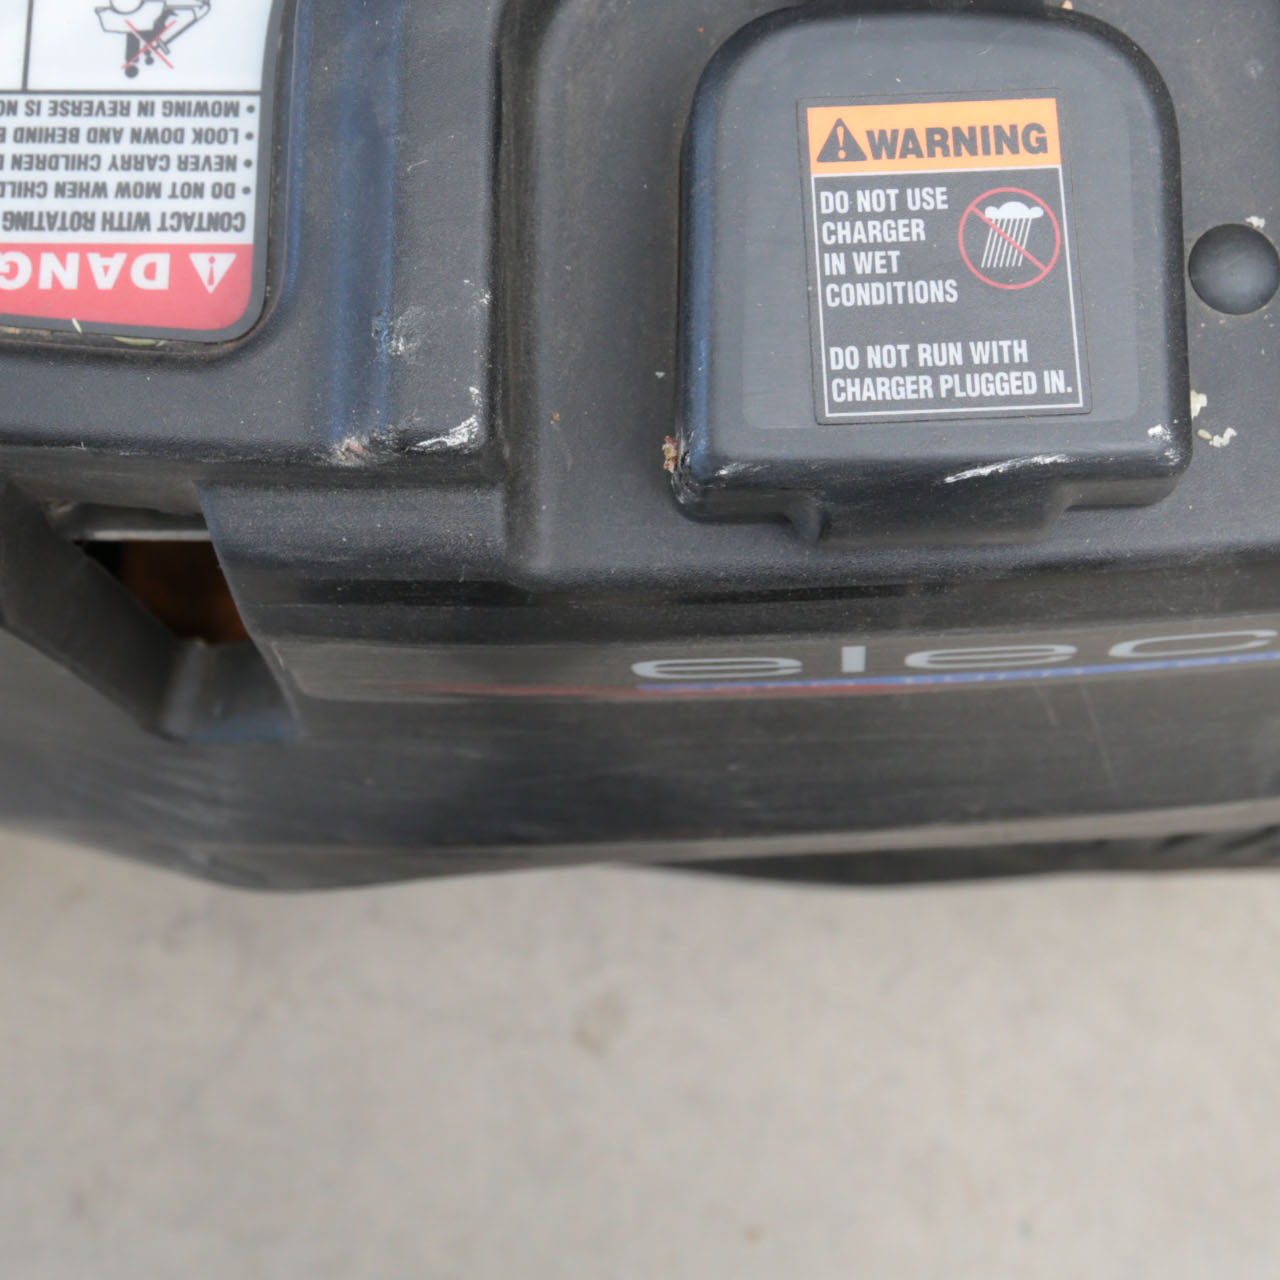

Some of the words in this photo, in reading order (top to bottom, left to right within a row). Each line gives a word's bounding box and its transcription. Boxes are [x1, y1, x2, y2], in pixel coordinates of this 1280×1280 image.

[23, 99, 43, 118] IS
[47, 99, 132, 118] REVERSE
[136, 99, 156, 118] IN
[161, 100, 241, 119] MOWING
[11, 126, 81, 145] BEHIND
[85, 126, 125, 145] AND
[129, 126, 186, 145] DOWN
[190, 126, 240, 146] LOOK
[865, 122, 1049, 162] WARNING
[9, 153, 103, 172] CHILDREN
[107, 153, 172, 173] CARRY
[176, 154, 239, 173] NEVER
[53, 180, 109, 200] WHEN
[113, 181, 163, 200] MOW
[167, 181, 206, 200] NOT
[210, 181, 237, 200] DO
[819, 190, 850, 215] DO
[855, 188, 900, 214] NOT
[906, 186, 950, 211] USE
[1, 210, 97, 233] ROTATING
[100, 211, 152, 233] WITH
[156, 211, 247, 233] CONTACT
[820, 218, 927, 246] CHARGER
[823, 251, 847, 277] IN
[852, 249, 901, 276] WET
[825, 278, 960, 308] CONDITIONS
[828, 345, 860, 371] DO
[866, 343, 911, 370] NOT
[917, 341, 964, 368] RUN
[968, 339, 1030, 366] WITH
[831, 374, 935, 403] CHARGER
[939, 370, 1038, 399] PLUGGED
[1043, 369, 1074, 395] IN.
